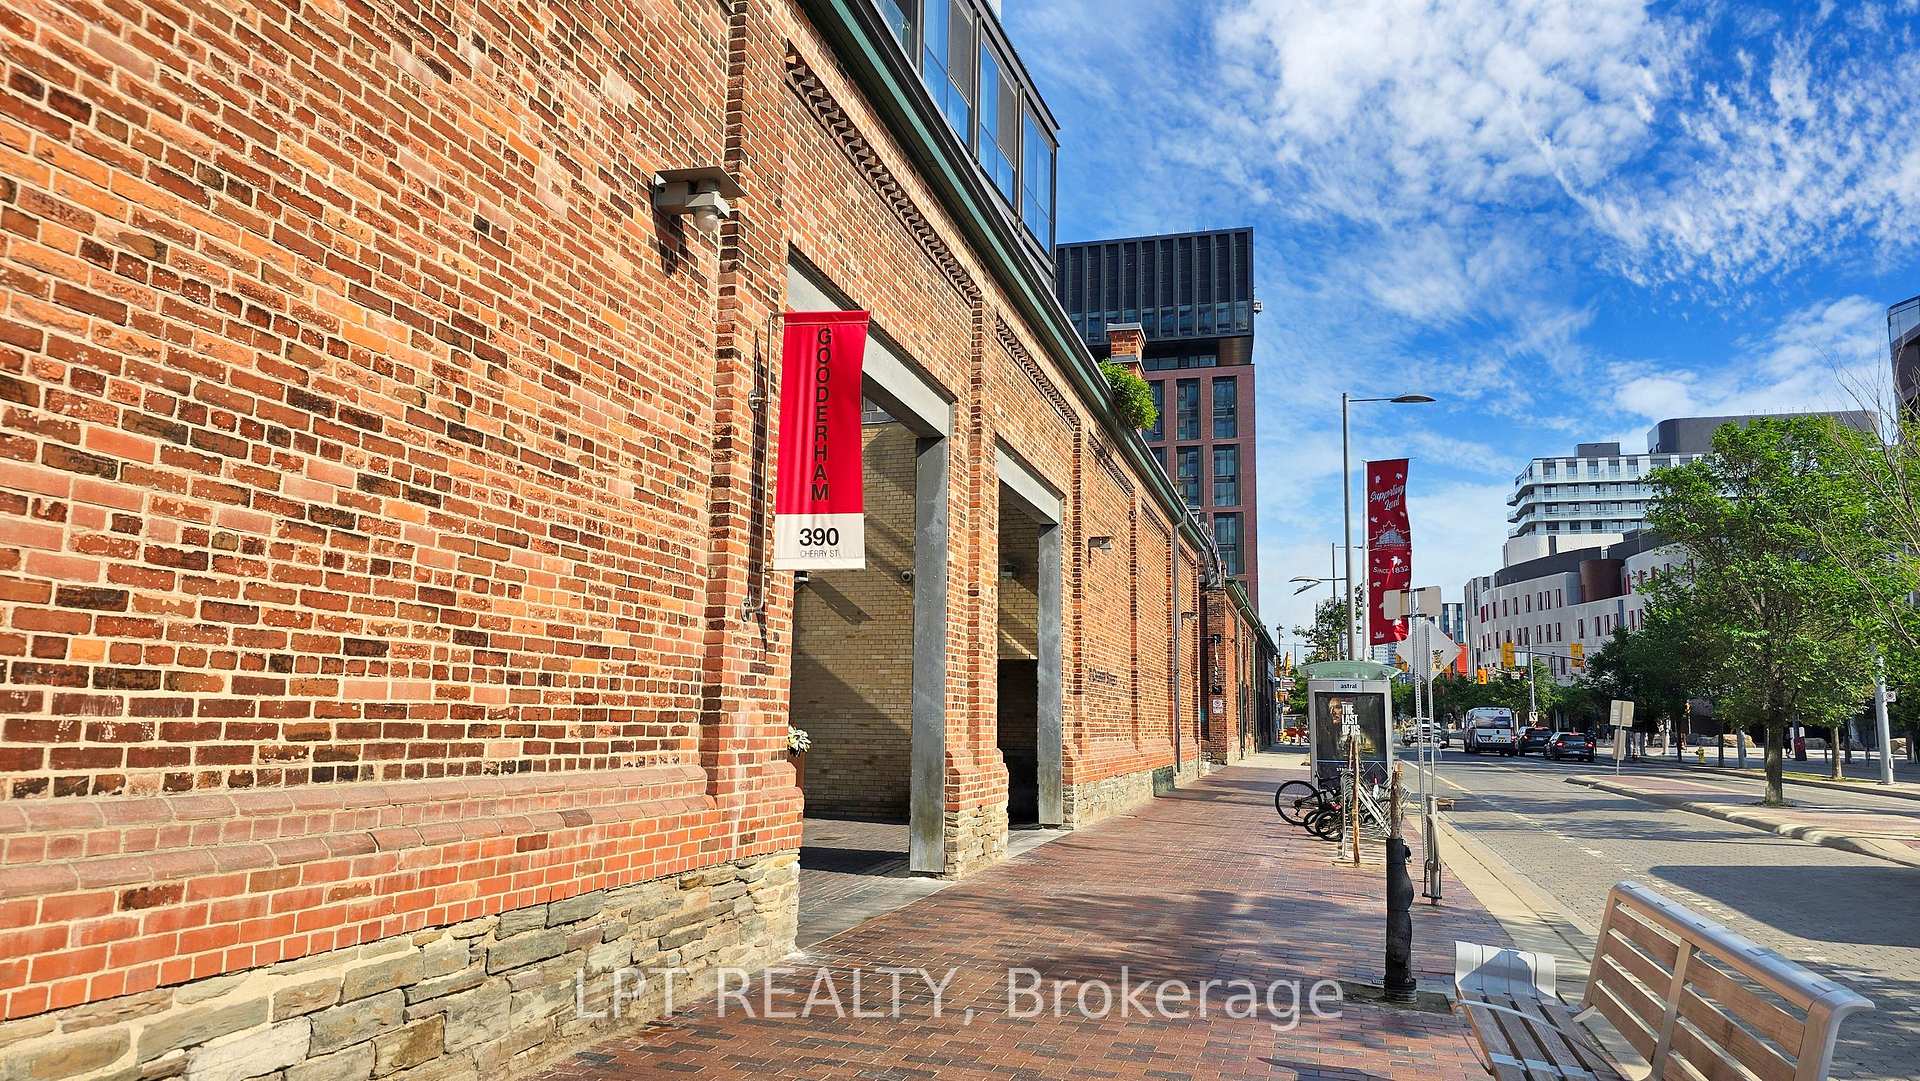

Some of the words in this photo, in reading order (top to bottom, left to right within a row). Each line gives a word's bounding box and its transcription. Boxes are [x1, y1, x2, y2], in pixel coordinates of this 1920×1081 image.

[811, 327, 832, 501] GOODERHAM
[1370, 484, 1404, 502] Supporting
[799, 527, 840, 547] 390
[800, 549, 828, 558] CHERRY
[1392, 565, 1409, 574] 1832
[1341, 704, 1354, 714] THE
[1341, 714, 1359, 725] LAST
[1341, 724, 1351, 736] OF
[1351, 724, 1361, 736] US
